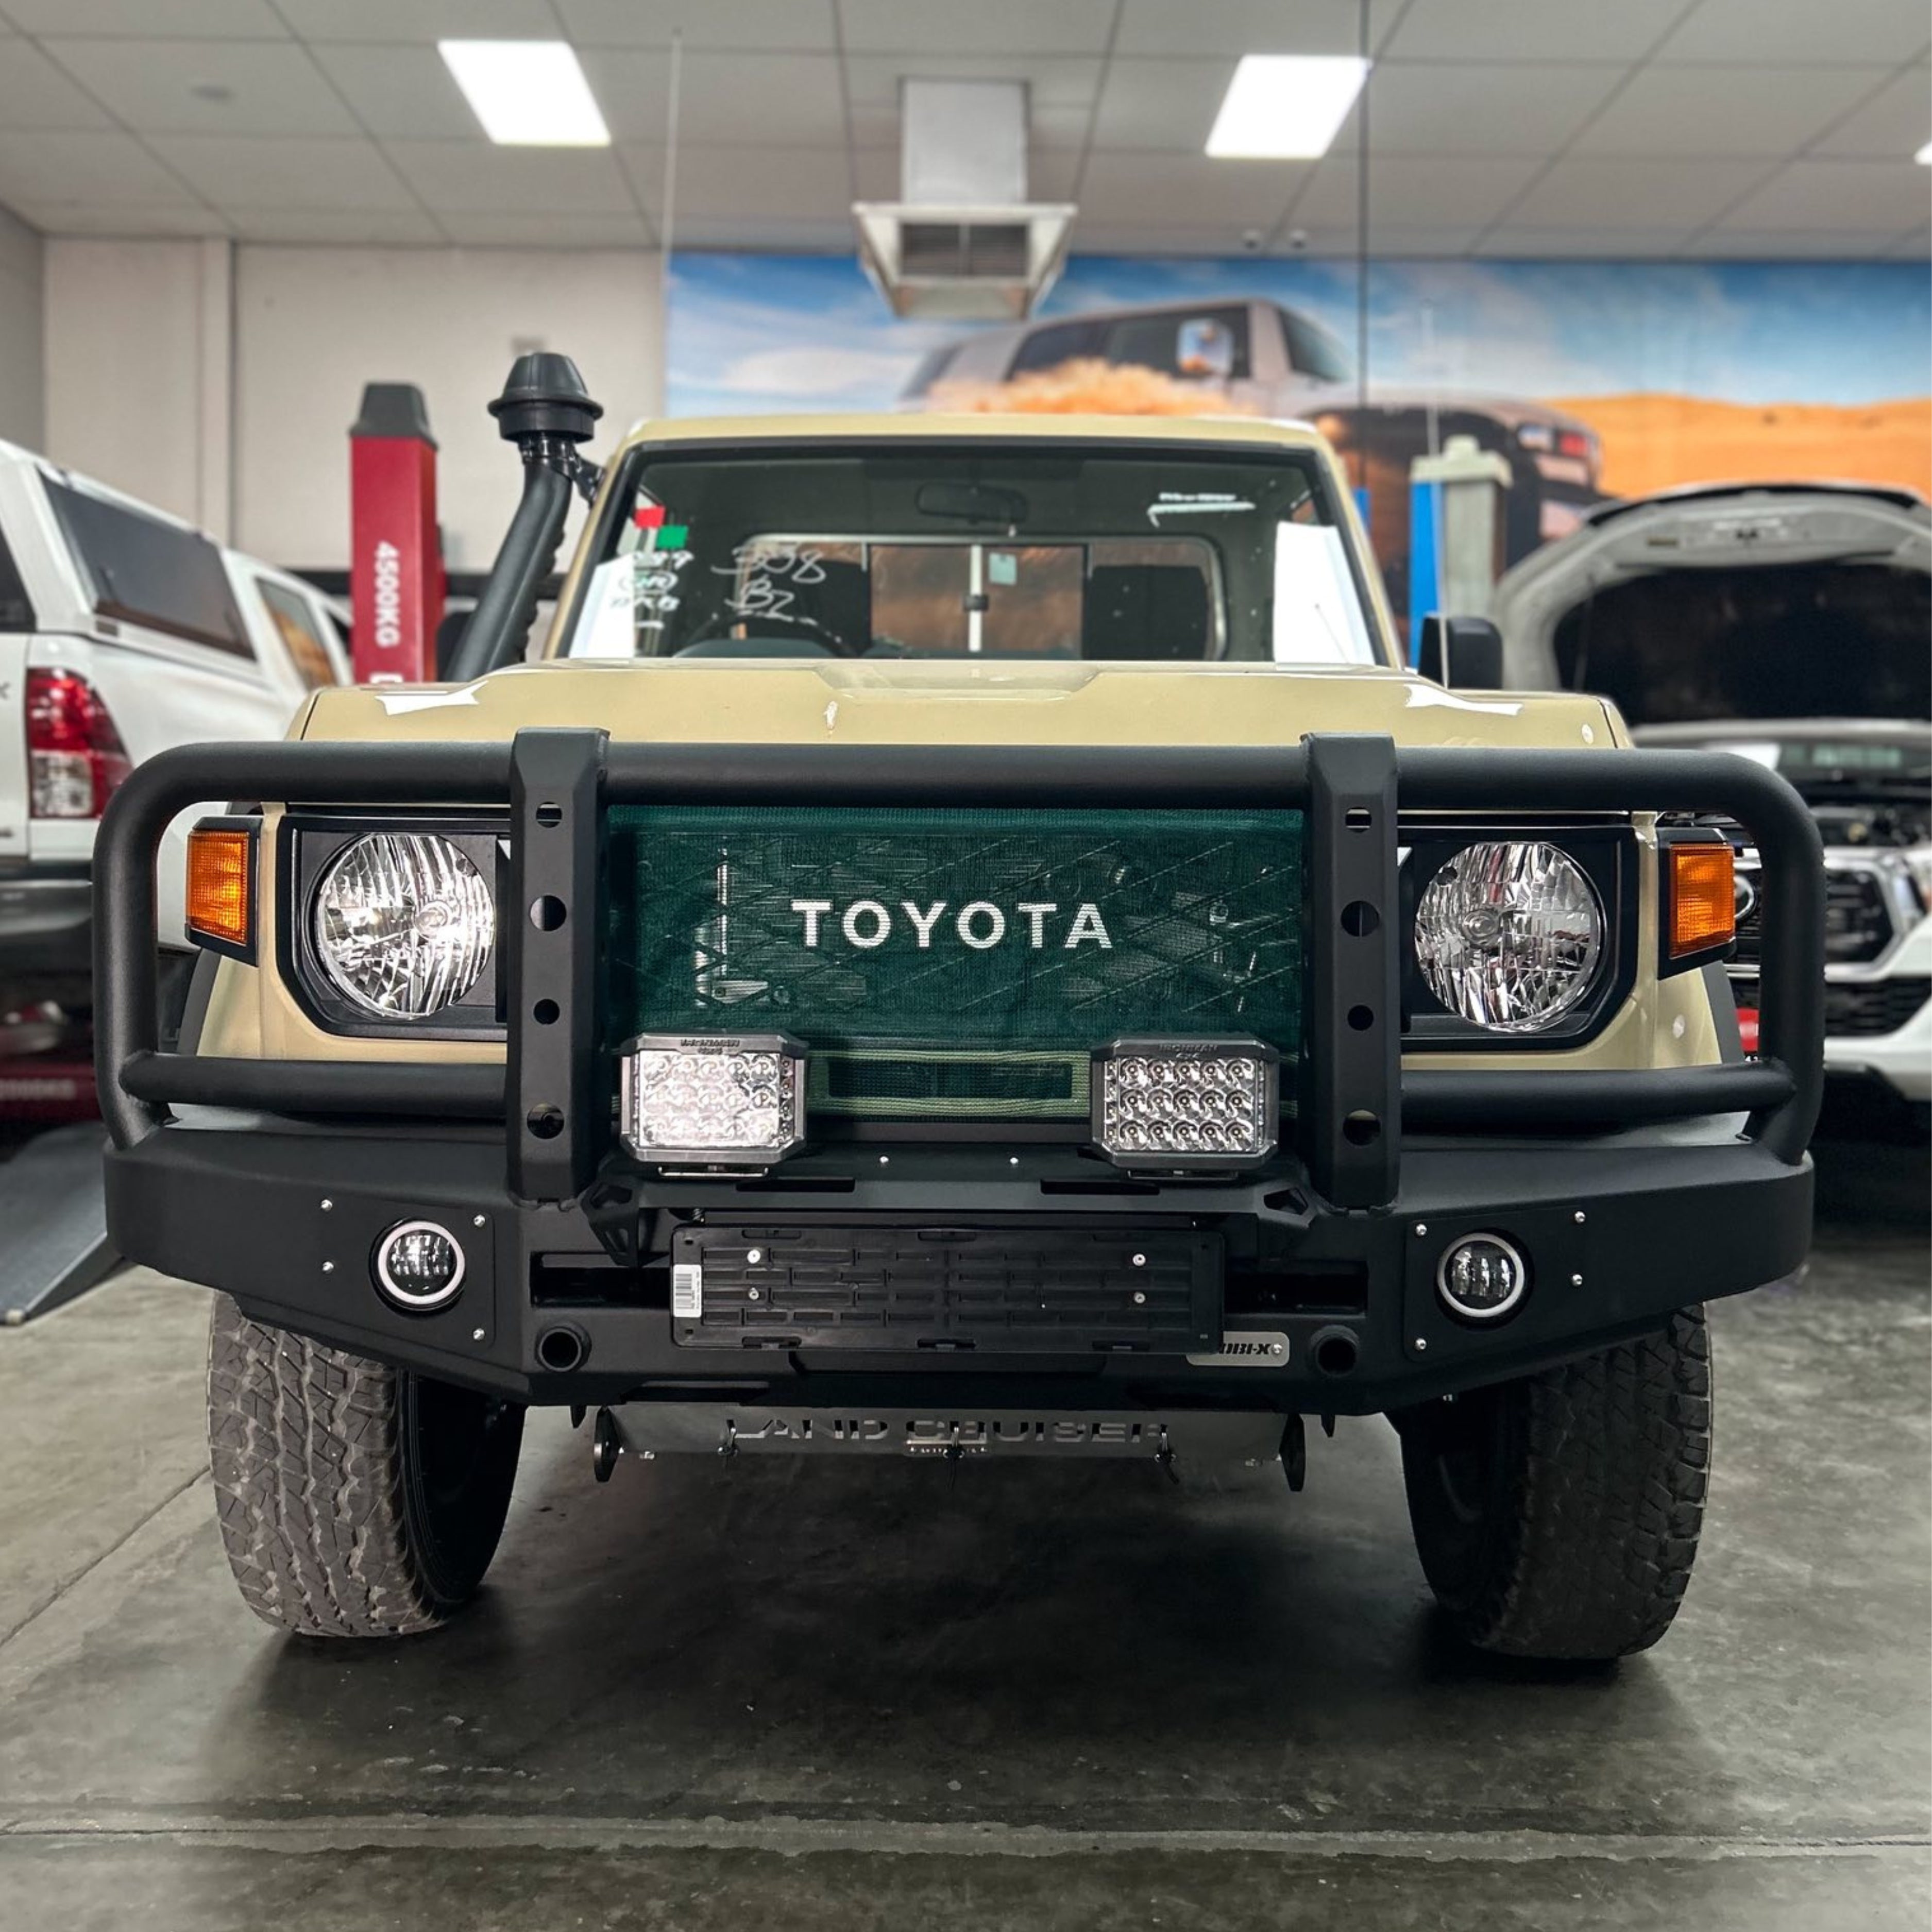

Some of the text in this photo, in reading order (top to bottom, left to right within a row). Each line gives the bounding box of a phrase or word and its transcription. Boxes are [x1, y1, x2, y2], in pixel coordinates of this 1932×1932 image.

[375, 540, 401, 648] 4500KG
[791, 900, 1113, 949] TOYOTA
[726, 1419, 888, 1439] LAND
